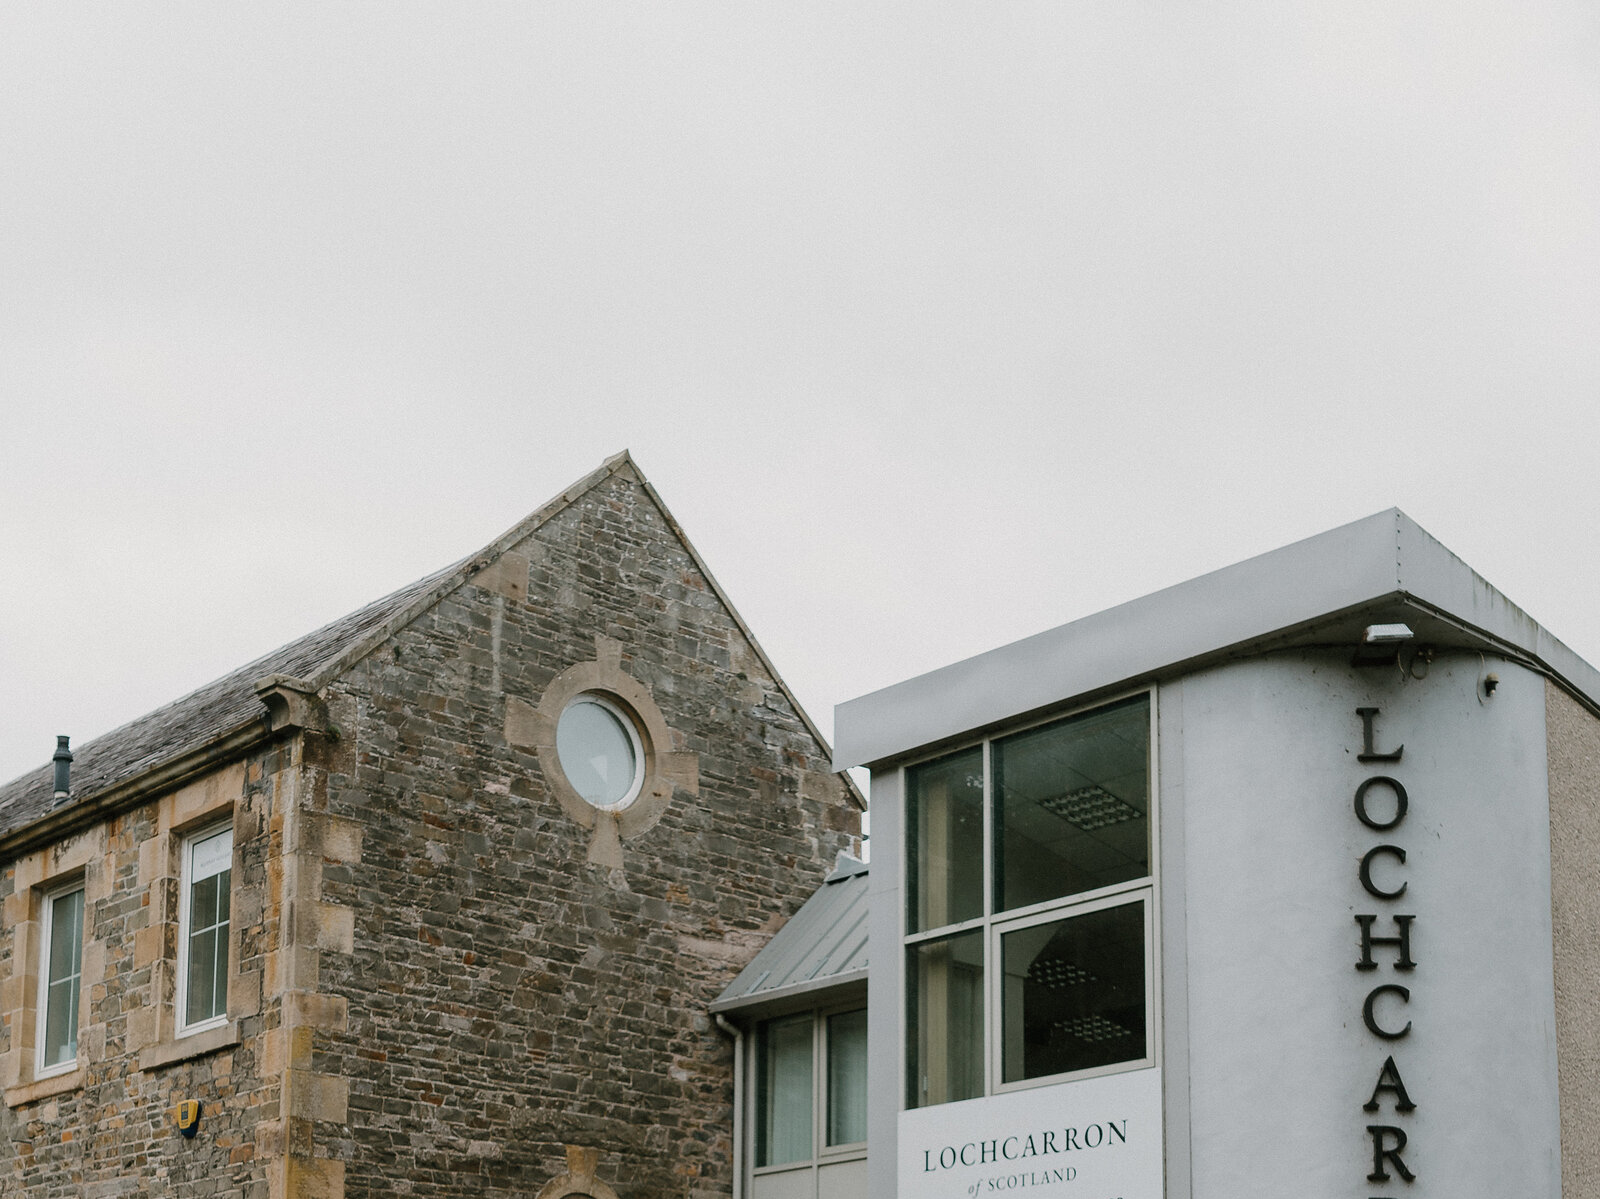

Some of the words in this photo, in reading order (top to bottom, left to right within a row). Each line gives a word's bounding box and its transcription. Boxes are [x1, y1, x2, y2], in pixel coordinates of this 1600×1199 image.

[924, 1119, 1128, 1172] LOCHCARRON
[967, 1179, 984, 1199] of
[988, 1166, 1077, 1192] SCOTLAND
